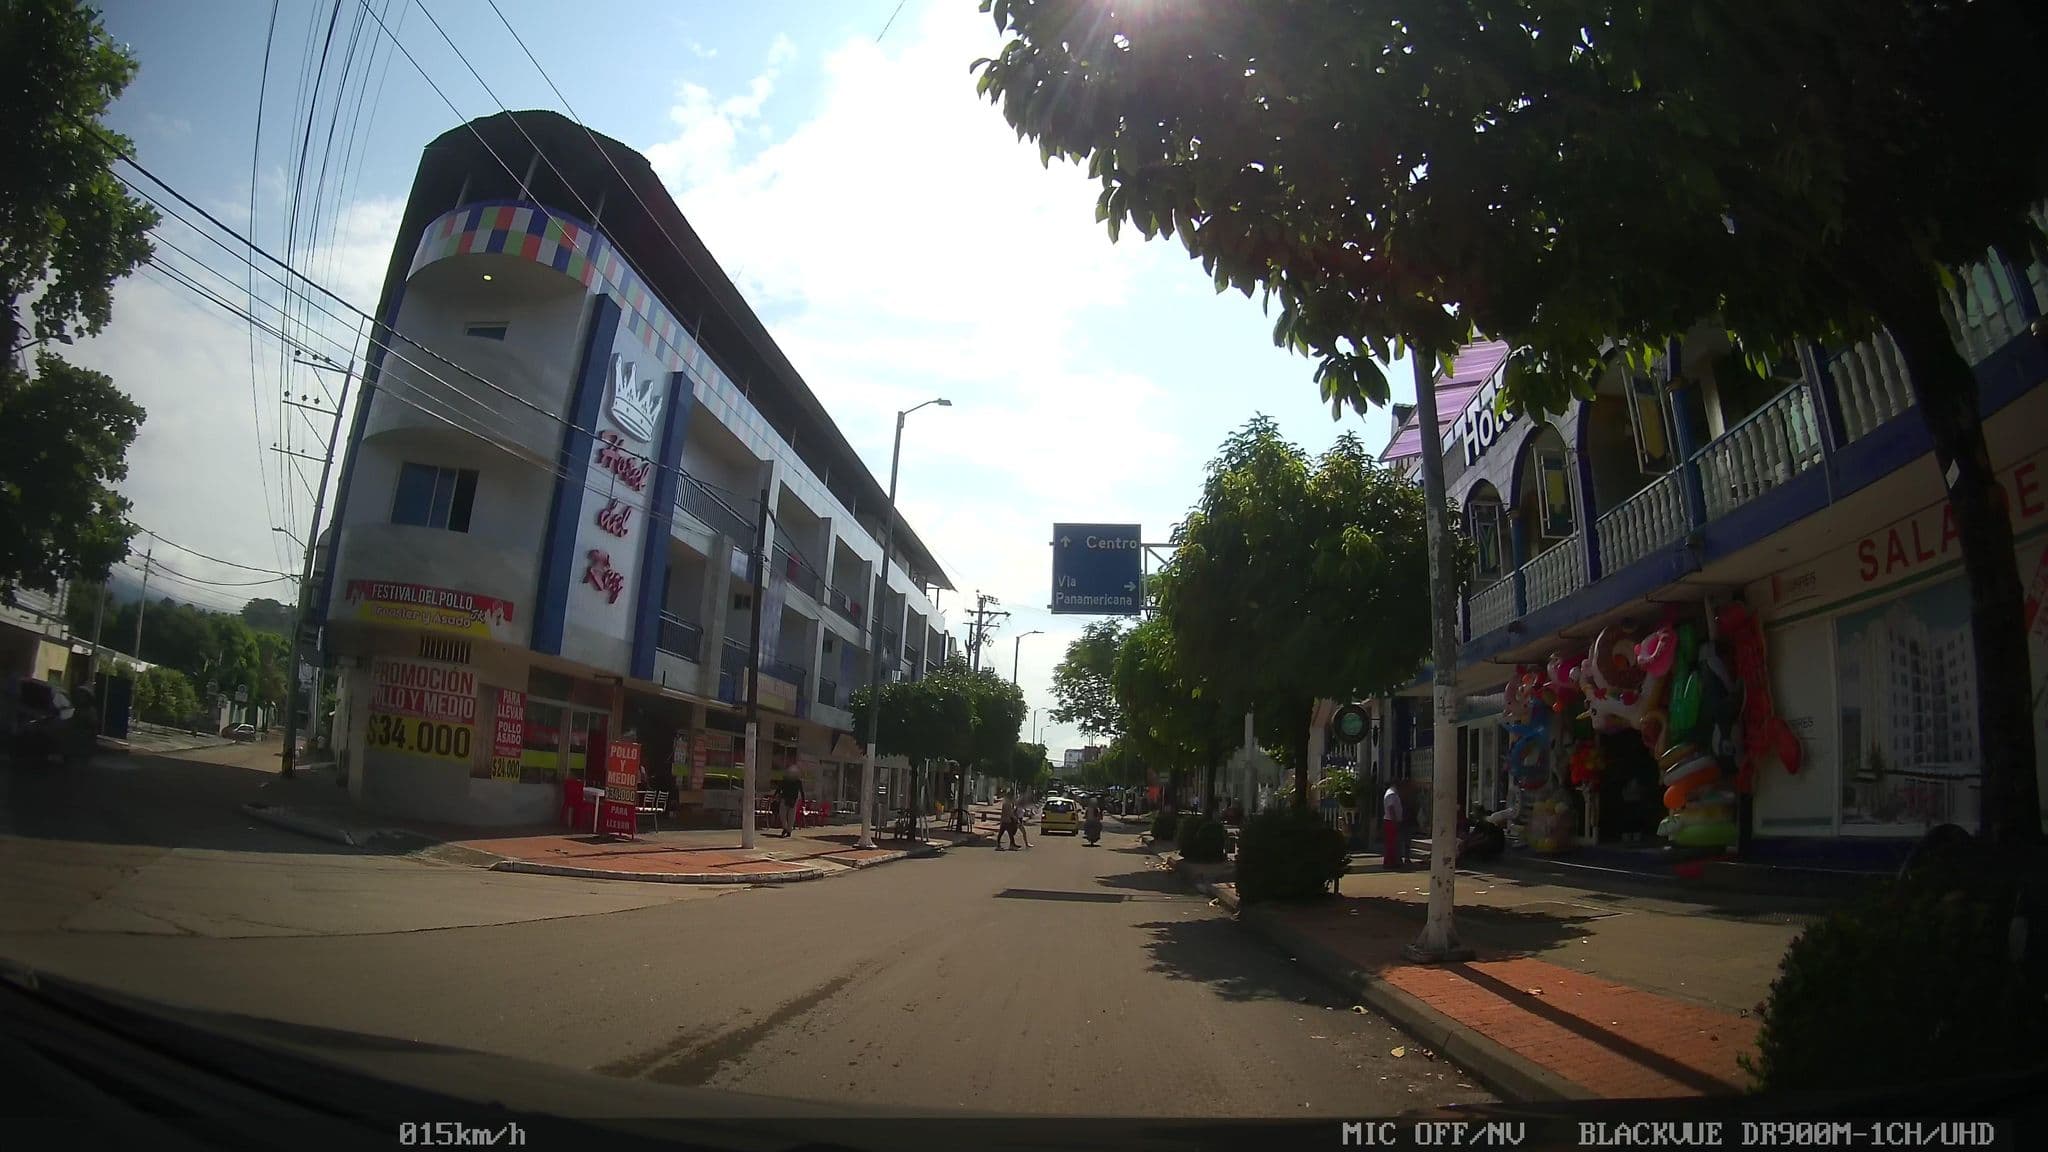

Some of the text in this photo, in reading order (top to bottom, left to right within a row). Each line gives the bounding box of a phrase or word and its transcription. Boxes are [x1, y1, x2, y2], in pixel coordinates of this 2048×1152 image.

[600, 498, 632, 537] del
[1086, 536, 1137, 549] Centro
[371, 583, 473, 610] FESTIVAL DEL POLLO
[1055, 592, 1133, 606] Panamericana
[432, 613, 471, 628] Asado
[374, 661, 474, 696] PROMOCIÓN
[409, 688, 420, 710] Y
[423, 690, 474, 719] MEDIO
[503, 689, 521, 706] PARA
[497, 703, 524, 721] LLEVAR
[498, 720, 522, 734] POLLO
[367, 713, 471, 758] $34.000
[496, 732, 522, 745] ASADO
[610, 745, 638, 760] POLLO
[620, 759, 626, 772] Y
[607, 771, 636, 786] MEDIO
[610, 805, 628, 817] PARA
